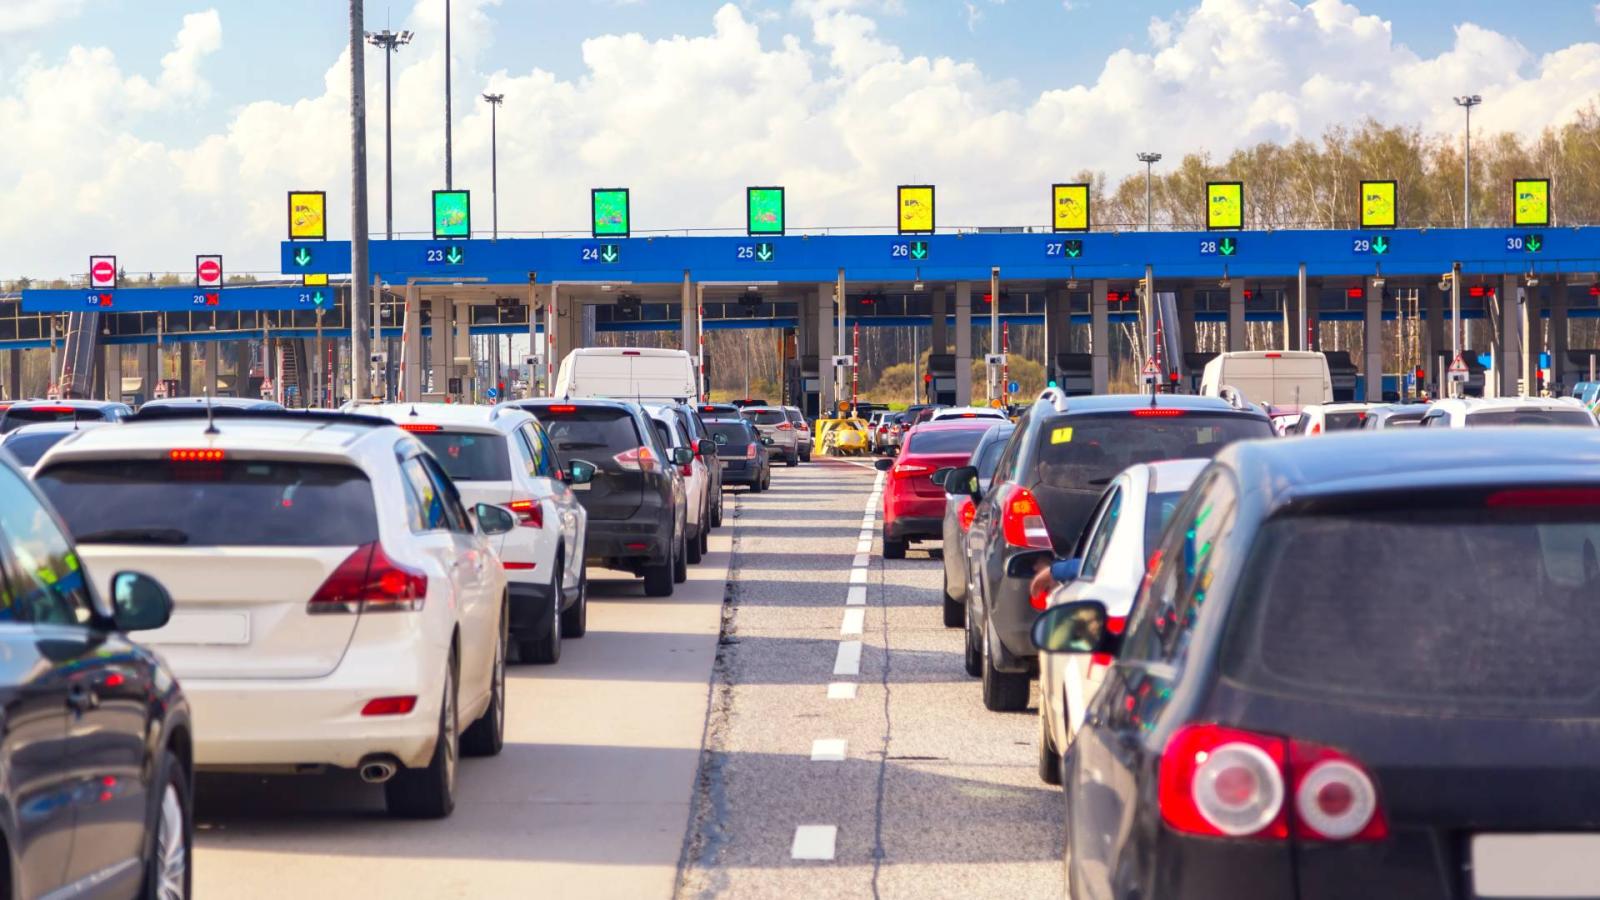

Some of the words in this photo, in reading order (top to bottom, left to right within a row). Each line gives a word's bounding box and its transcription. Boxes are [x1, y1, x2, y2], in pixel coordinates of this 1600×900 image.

[1047, 243, 1062, 254] 27
[1201, 242, 1216, 253] 28
[1354, 240, 1369, 251] 29
[1507, 238, 1523, 249] 30
[582, 248, 598, 260] 24
[737, 247, 753, 258] 25
[892, 244, 908, 256] 26
[427, 250, 443, 262] 23
[87, 296, 98, 304] 19
[193, 295, 204, 304] 20
[299, 294, 310, 303] 21
